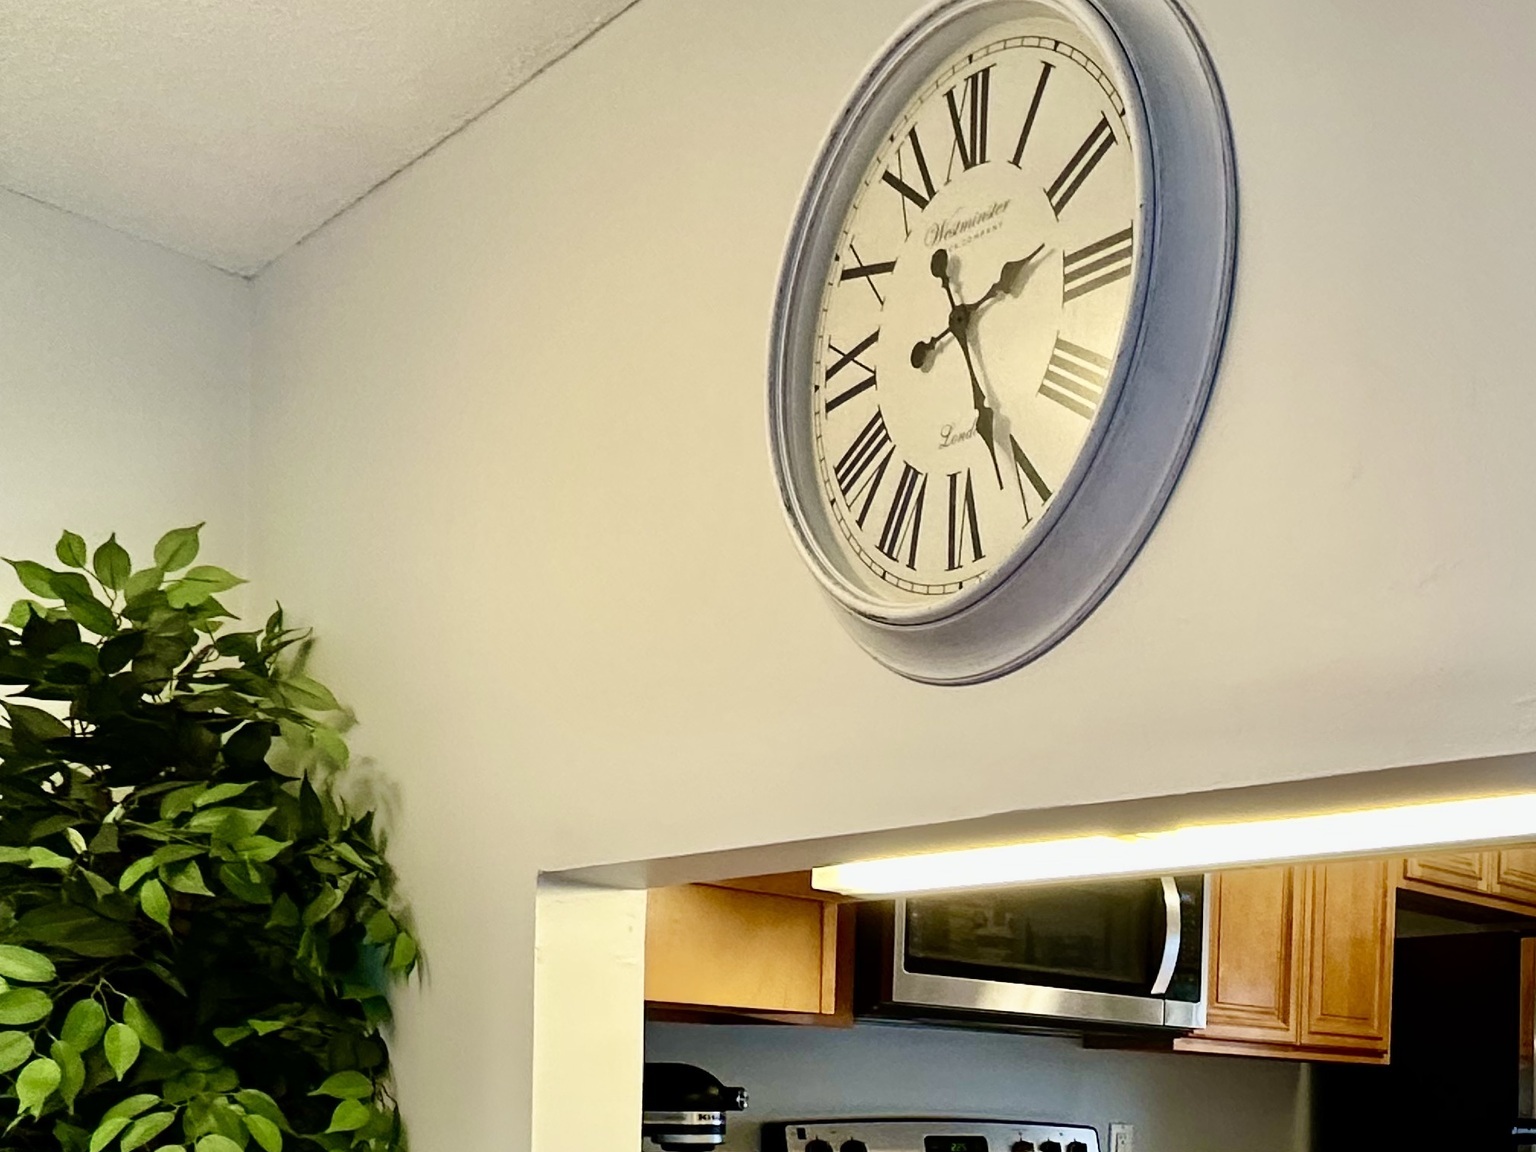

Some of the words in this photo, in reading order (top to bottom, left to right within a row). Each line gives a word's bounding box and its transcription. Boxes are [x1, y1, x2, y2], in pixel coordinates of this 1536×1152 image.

[942, 62, 997, 186] XII
[1042, 110, 1119, 222] II
[878, 121, 939, 242] XI
[924, 199, 1011, 248] Westminster
[837, 234, 898, 312] X
[1062, 219, 1134, 309] III
[825, 325, 881, 420] IX
[833, 404, 896, 531] VIII
[875, 460, 928, 571] VII
[944, 467, 986, 572] VI
[1009, 433, 1053, 529] V
